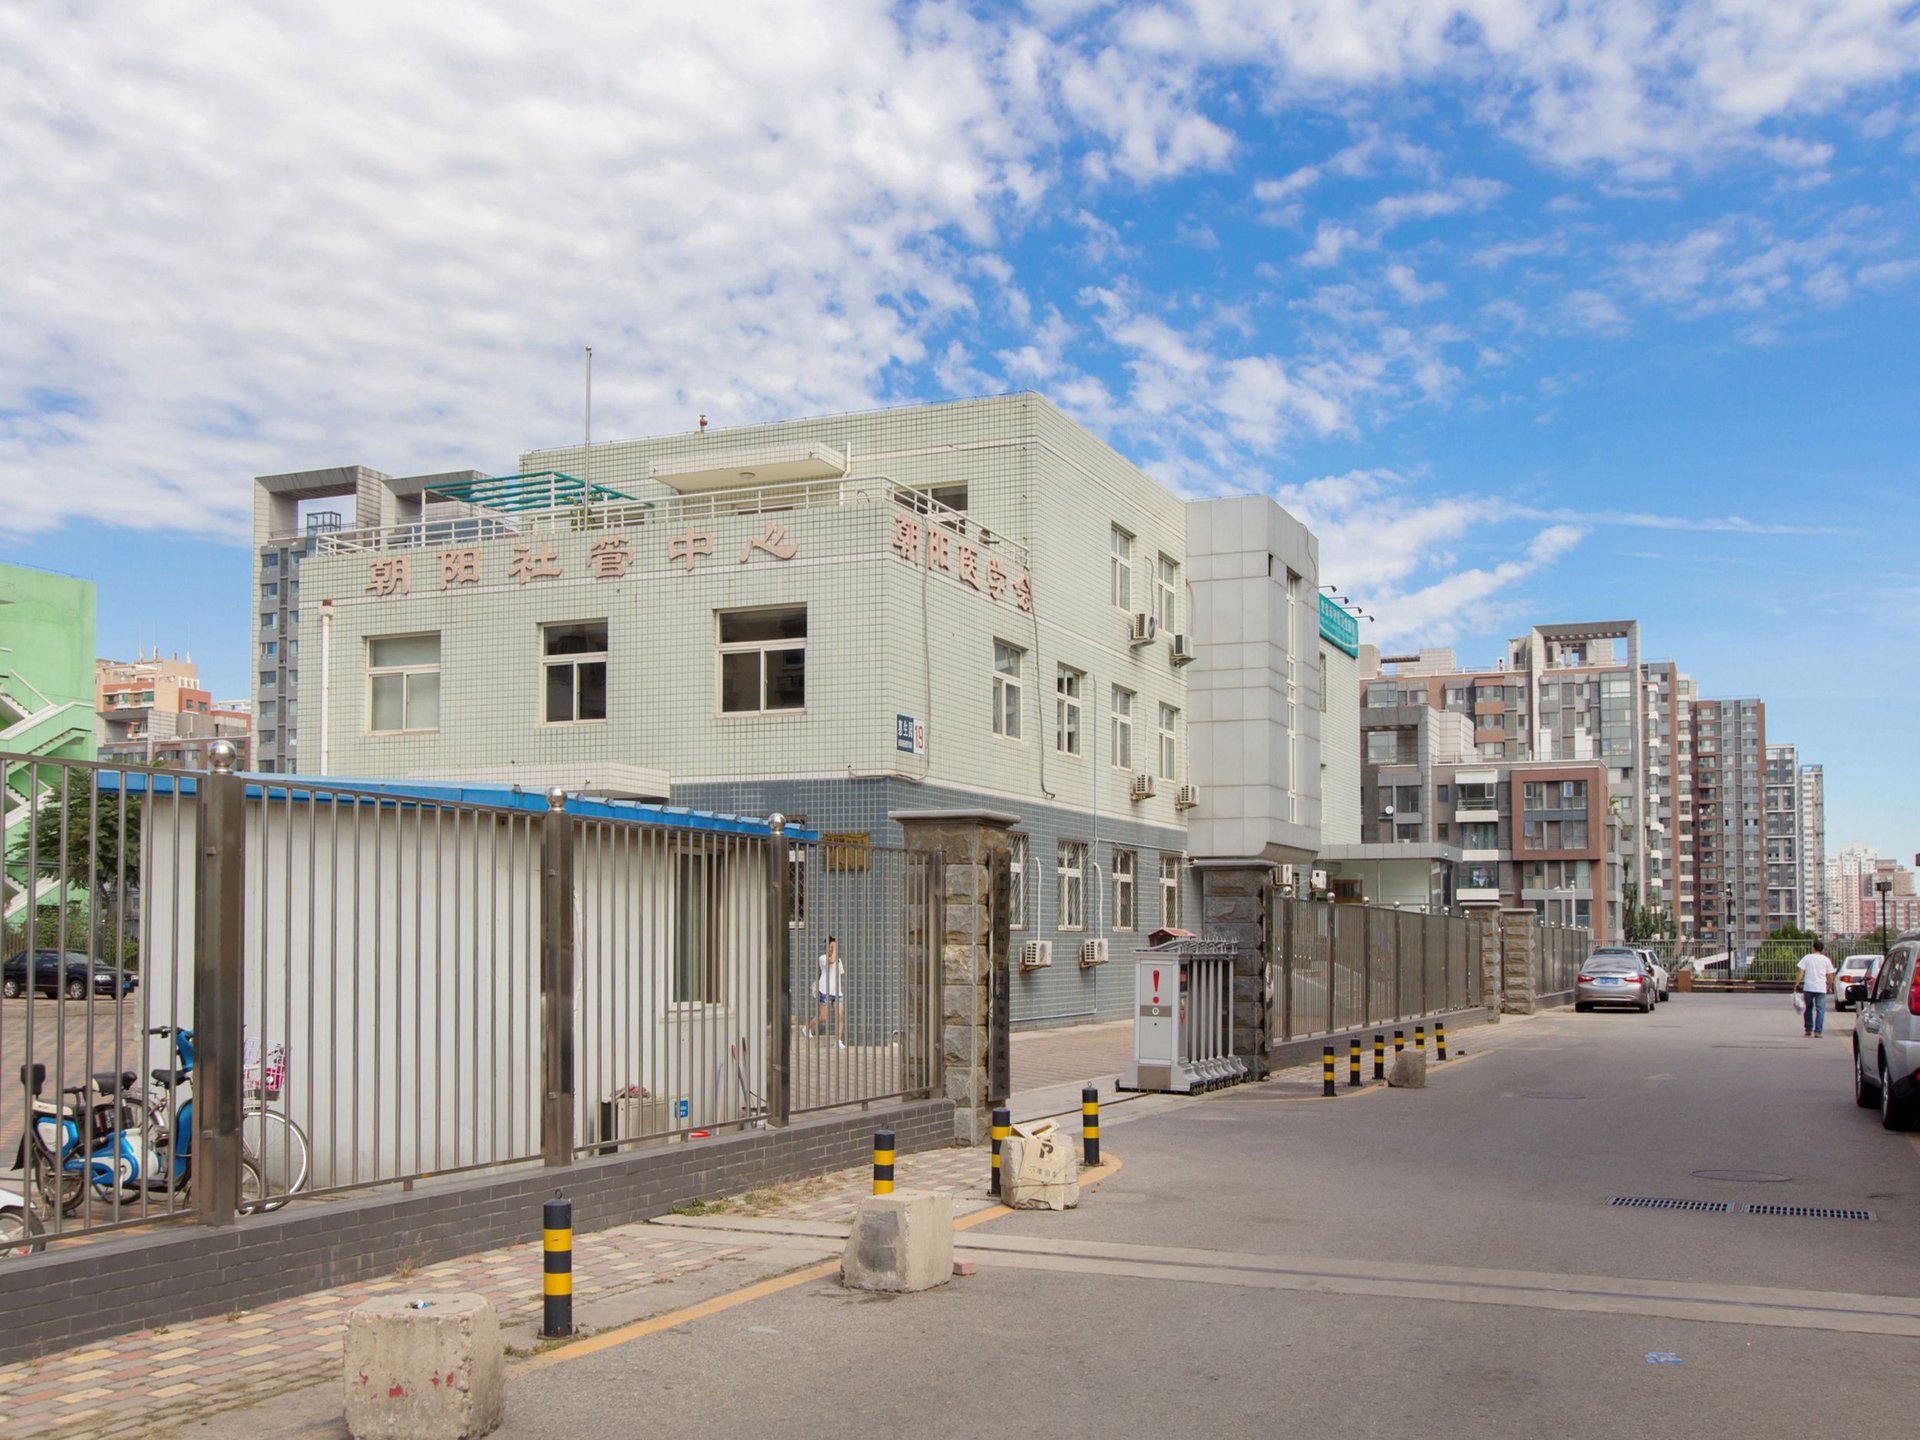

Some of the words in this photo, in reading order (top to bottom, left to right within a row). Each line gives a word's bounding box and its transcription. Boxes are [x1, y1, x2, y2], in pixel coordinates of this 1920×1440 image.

[366, 522, 799, 596] 朝阳社管中心
[892, 513, 1032, 612] 朝阳医学会
